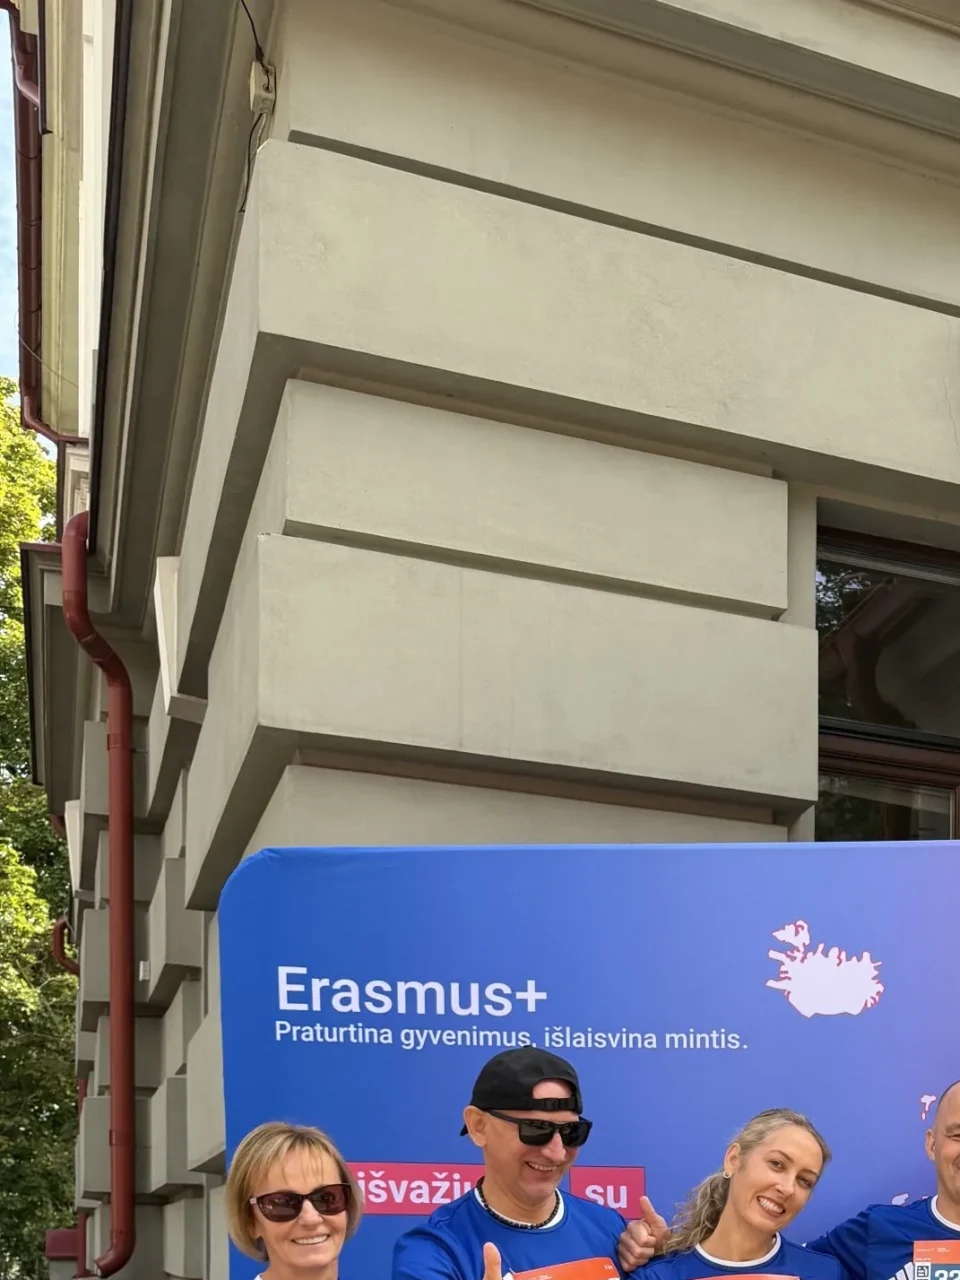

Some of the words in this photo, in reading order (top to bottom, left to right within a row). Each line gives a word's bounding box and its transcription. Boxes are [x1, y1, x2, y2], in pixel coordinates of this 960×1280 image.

[277, 965, 547, 1016] Erasmus+
[275, 1020, 393, 1044] Praturtina
[400, 1025, 537, 1050] gyvenimus,
[544, 1026, 657, 1048] išlaisvina
[665, 1028, 748, 1049] mintis.
[585, 1184, 627, 1209] su
